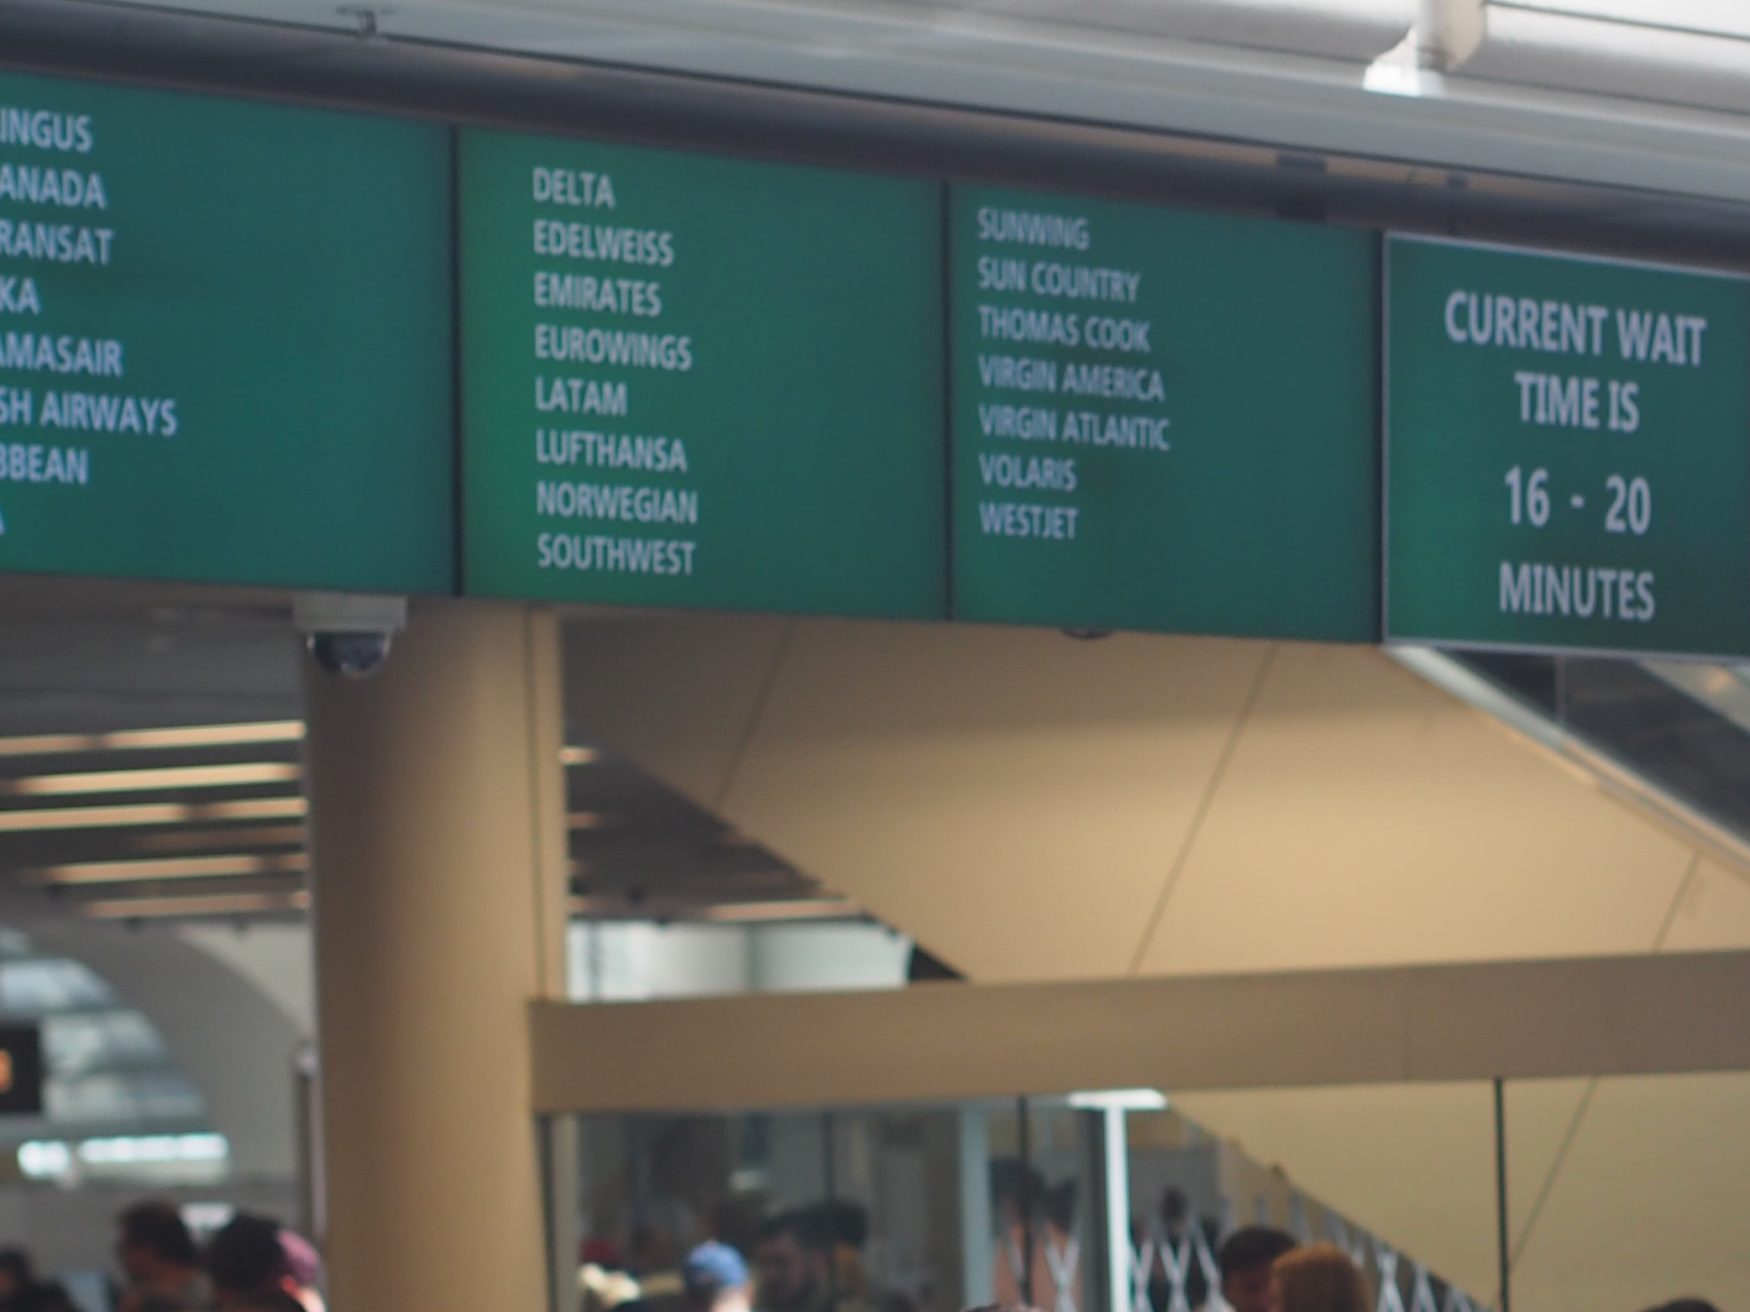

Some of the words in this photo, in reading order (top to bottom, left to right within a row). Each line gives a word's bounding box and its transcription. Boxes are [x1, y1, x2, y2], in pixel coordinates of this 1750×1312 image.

[0, 163, 107, 209] ANADA
[532, 166, 616, 208] DELTA
[533, 218, 675, 267] EDELWEISS
[976, 206, 1091, 251] SUNWING
[534, 271, 662, 317] EMIRATES
[976, 255, 1026, 293] SUN
[1031, 260, 1140, 303] COUNTRY
[535, 323, 693, 371] EUROWINGS
[977, 304, 1080, 347] THOMAS
[1084, 315, 1151, 353] COOK
[1444, 290, 1608, 355] CURRENT
[1616, 307, 1707, 367] WAIT
[0, 331, 123, 377] MASAIR
[535, 375, 628, 417] LATAM
[977, 354, 1057, 392] VIRGIN
[1061, 362, 1165, 402] AMERICA
[1514, 370, 1600, 430] TIME
[1607, 380, 1641, 432] IS
[40, 390, 178, 436] AIRWAYS
[978, 403, 1057, 441] VIRGIN
[1061, 409, 1171, 452] ATLANTIC
[536, 428, 688, 473] LUFTHANSA
[978, 452, 1078, 492] VOLARIS
[537, 480, 699, 525] NORWEGIAN
[978, 501, 1080, 540] WESTJET
[1504, 465, 1551, 528] 16
[1604, 474, 1652, 535] 20
[537, 532, 696, 576] SOUTHWEST
[1499, 561, 1656, 621] MINUTES
